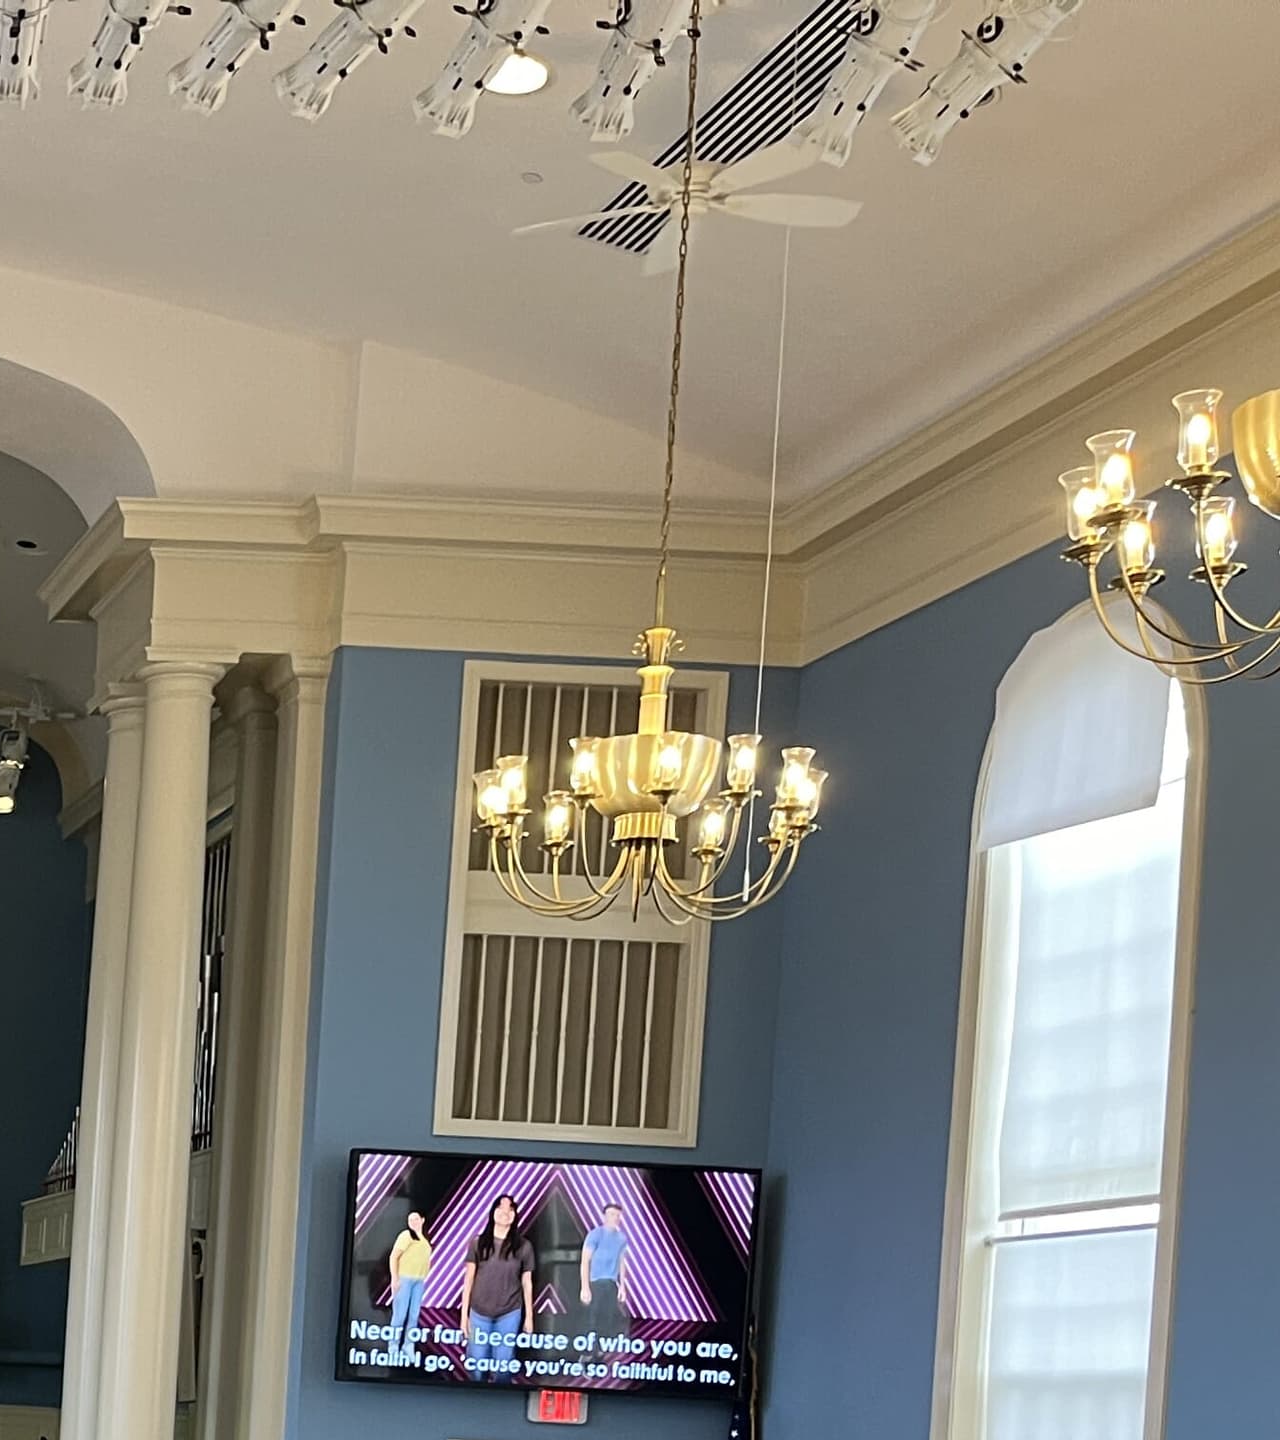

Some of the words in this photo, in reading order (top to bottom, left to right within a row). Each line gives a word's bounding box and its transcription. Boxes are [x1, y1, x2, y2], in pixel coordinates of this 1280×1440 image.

[350, 1320, 403, 1340] Near
[408, 1327, 430, 1342] or
[433, 1324, 468, 1347] far,
[475, 1327, 569, 1350] because
[573, 1332, 596, 1351] of
[600, 1334, 645, 1353] who
[651, 1340, 691, 1359] you
[696, 1342, 738, 1361] are,
[349, 1348, 366, 1365] In
[370, 1349, 410, 1367] faith
[415, 1352, 421, 1367] I
[425, 1355, 454, 1371] go,
[587, 1363, 608, 1378] so
[612, 1361, 673, 1381] faithful
[677, 1364, 696, 1382] to
[700, 1369, 735, 1386] me,
[541, 1390, 581, 1421] EXIT
